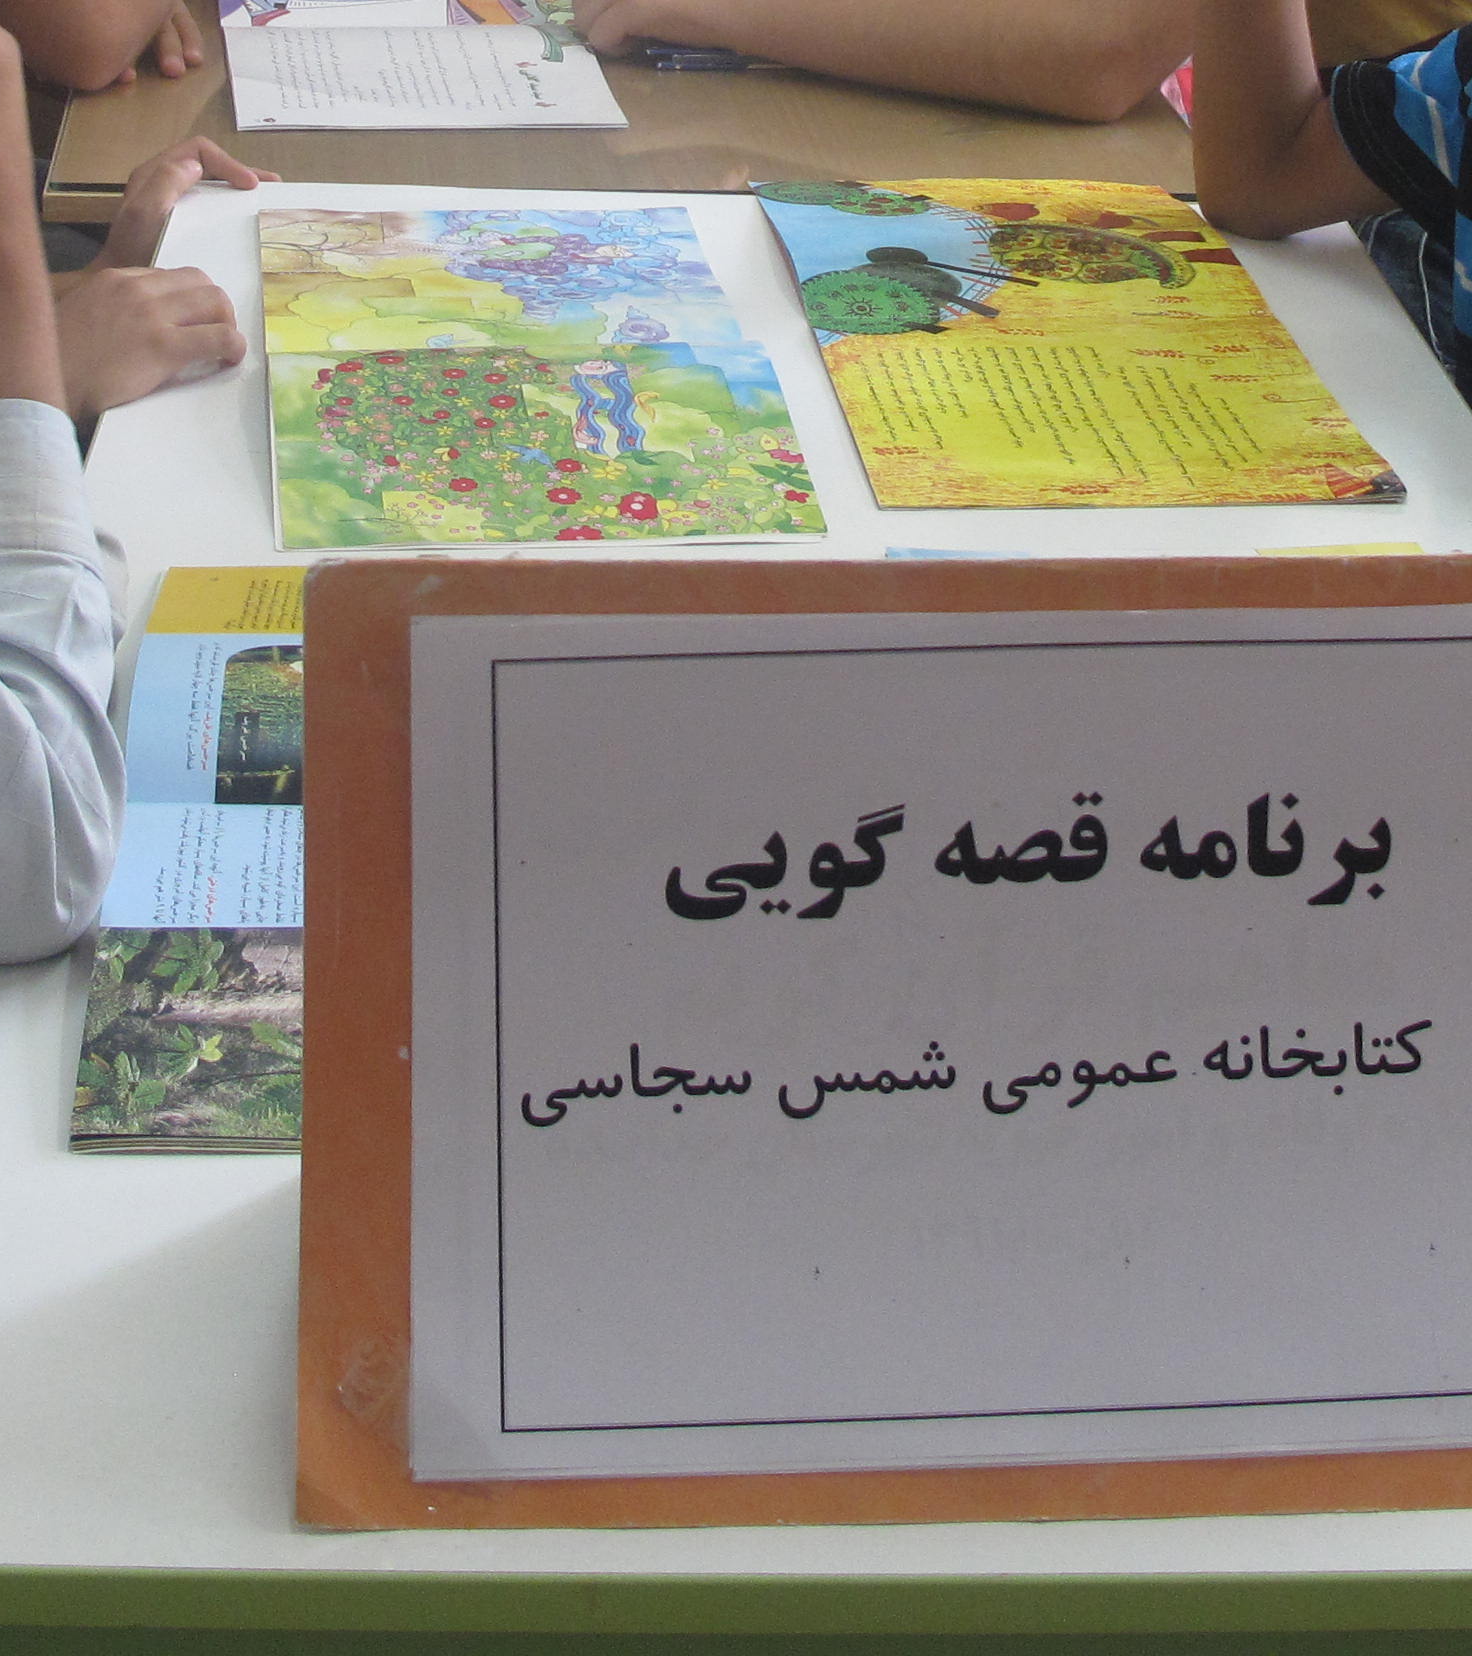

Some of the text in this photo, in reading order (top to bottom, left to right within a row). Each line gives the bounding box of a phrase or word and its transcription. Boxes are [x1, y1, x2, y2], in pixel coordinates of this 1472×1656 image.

[664, 790, 1394, 922] برنامه قصه گویی
[520, 1018, 1434, 1129] کتابخانه عمومی شمس سجاسی
